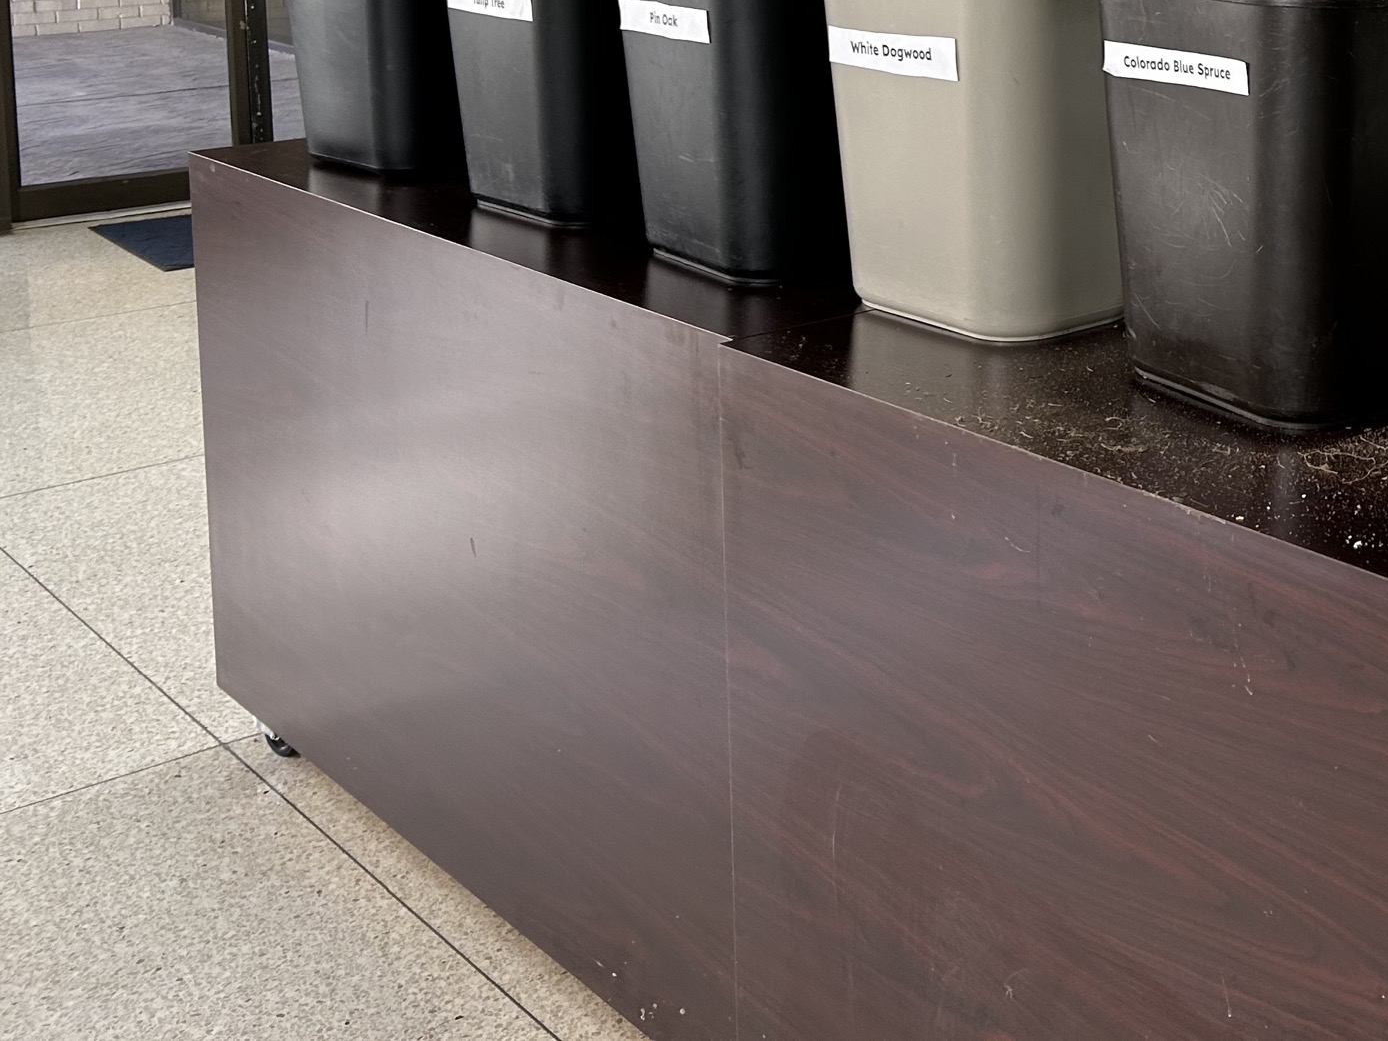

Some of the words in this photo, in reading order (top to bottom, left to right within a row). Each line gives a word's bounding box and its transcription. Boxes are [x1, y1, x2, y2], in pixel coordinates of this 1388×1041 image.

[650, 12, 661, 25] Pin
[662, 14, 679, 28] Oak
[850, 40, 880, 57] White
[882, 44, 933, 63] Dogwood
[1123, 55, 1171, 72] Colorado
[1173, 59, 1195, 75] Blue
[1197, 63, 1232, 80] Spruce
